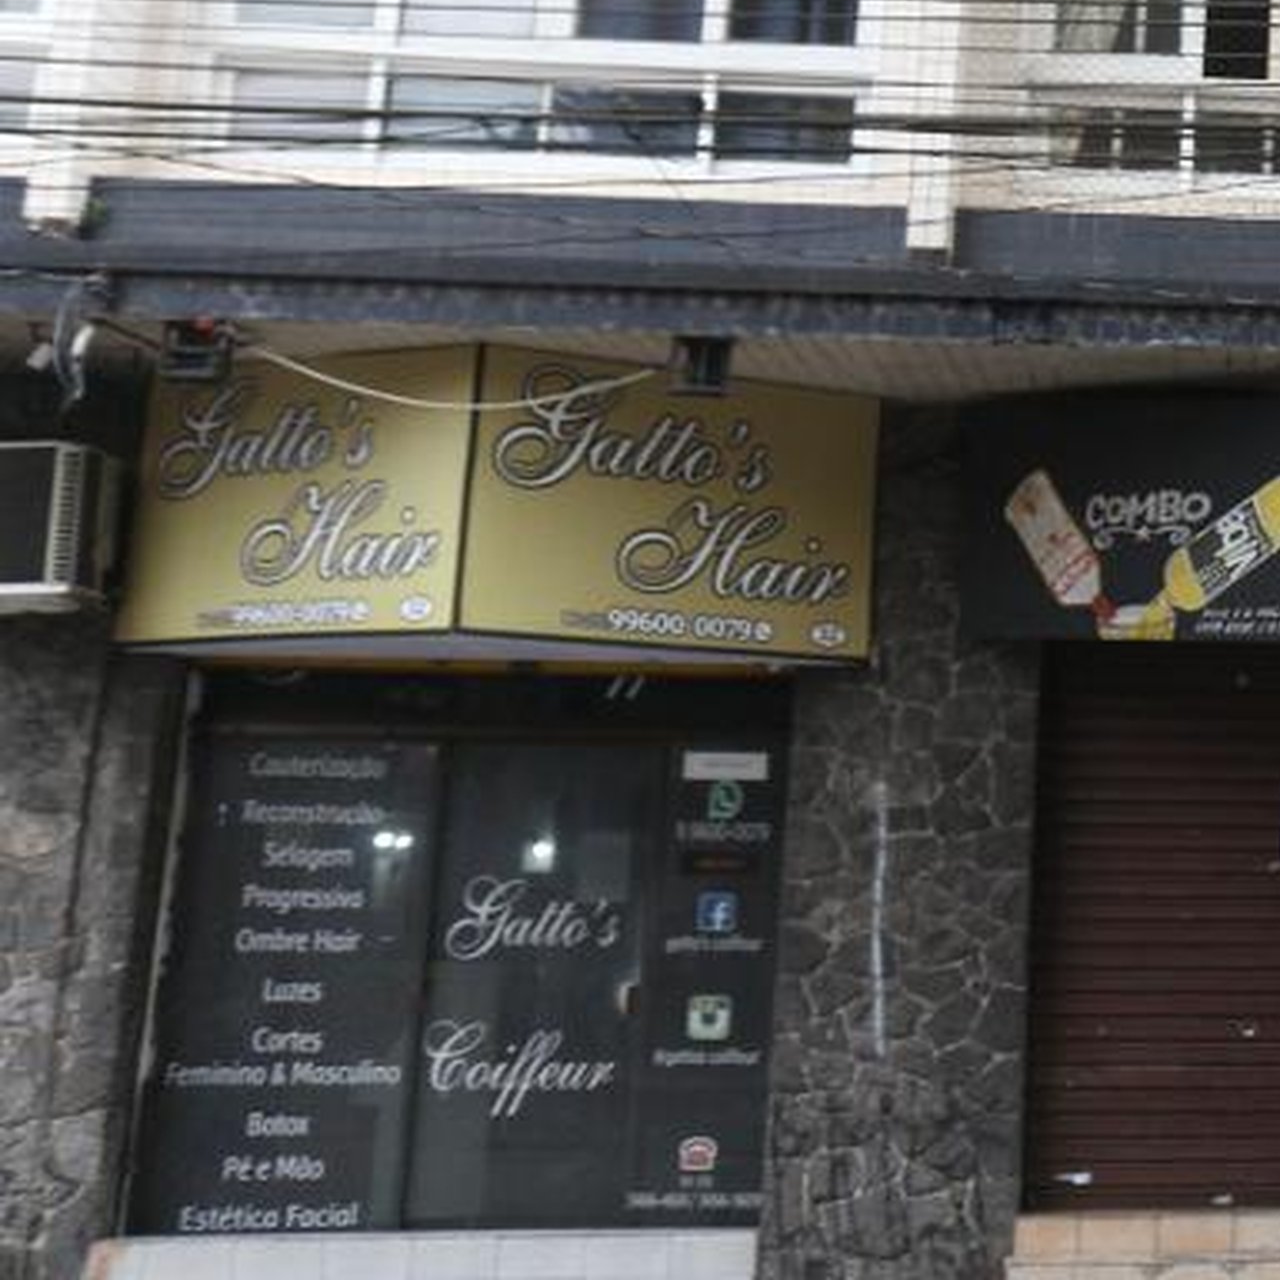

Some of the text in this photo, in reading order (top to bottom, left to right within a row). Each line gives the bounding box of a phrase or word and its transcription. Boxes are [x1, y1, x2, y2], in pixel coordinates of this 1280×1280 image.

[158, 382, 375, 500] Gatto's
[495, 363, 775, 492] Gatto's
[240, 480, 440, 586] Hair
[616, 497, 852, 604] Hair
[1085, 490, 1213, 530] COMBO
[445, 875, 621, 961] Gatto's
[251, 1025, 324, 1054] Cortes
[423, 1019, 616, 1118] Coiffeur
[178, 1200, 360, 1232] Estética Facial
